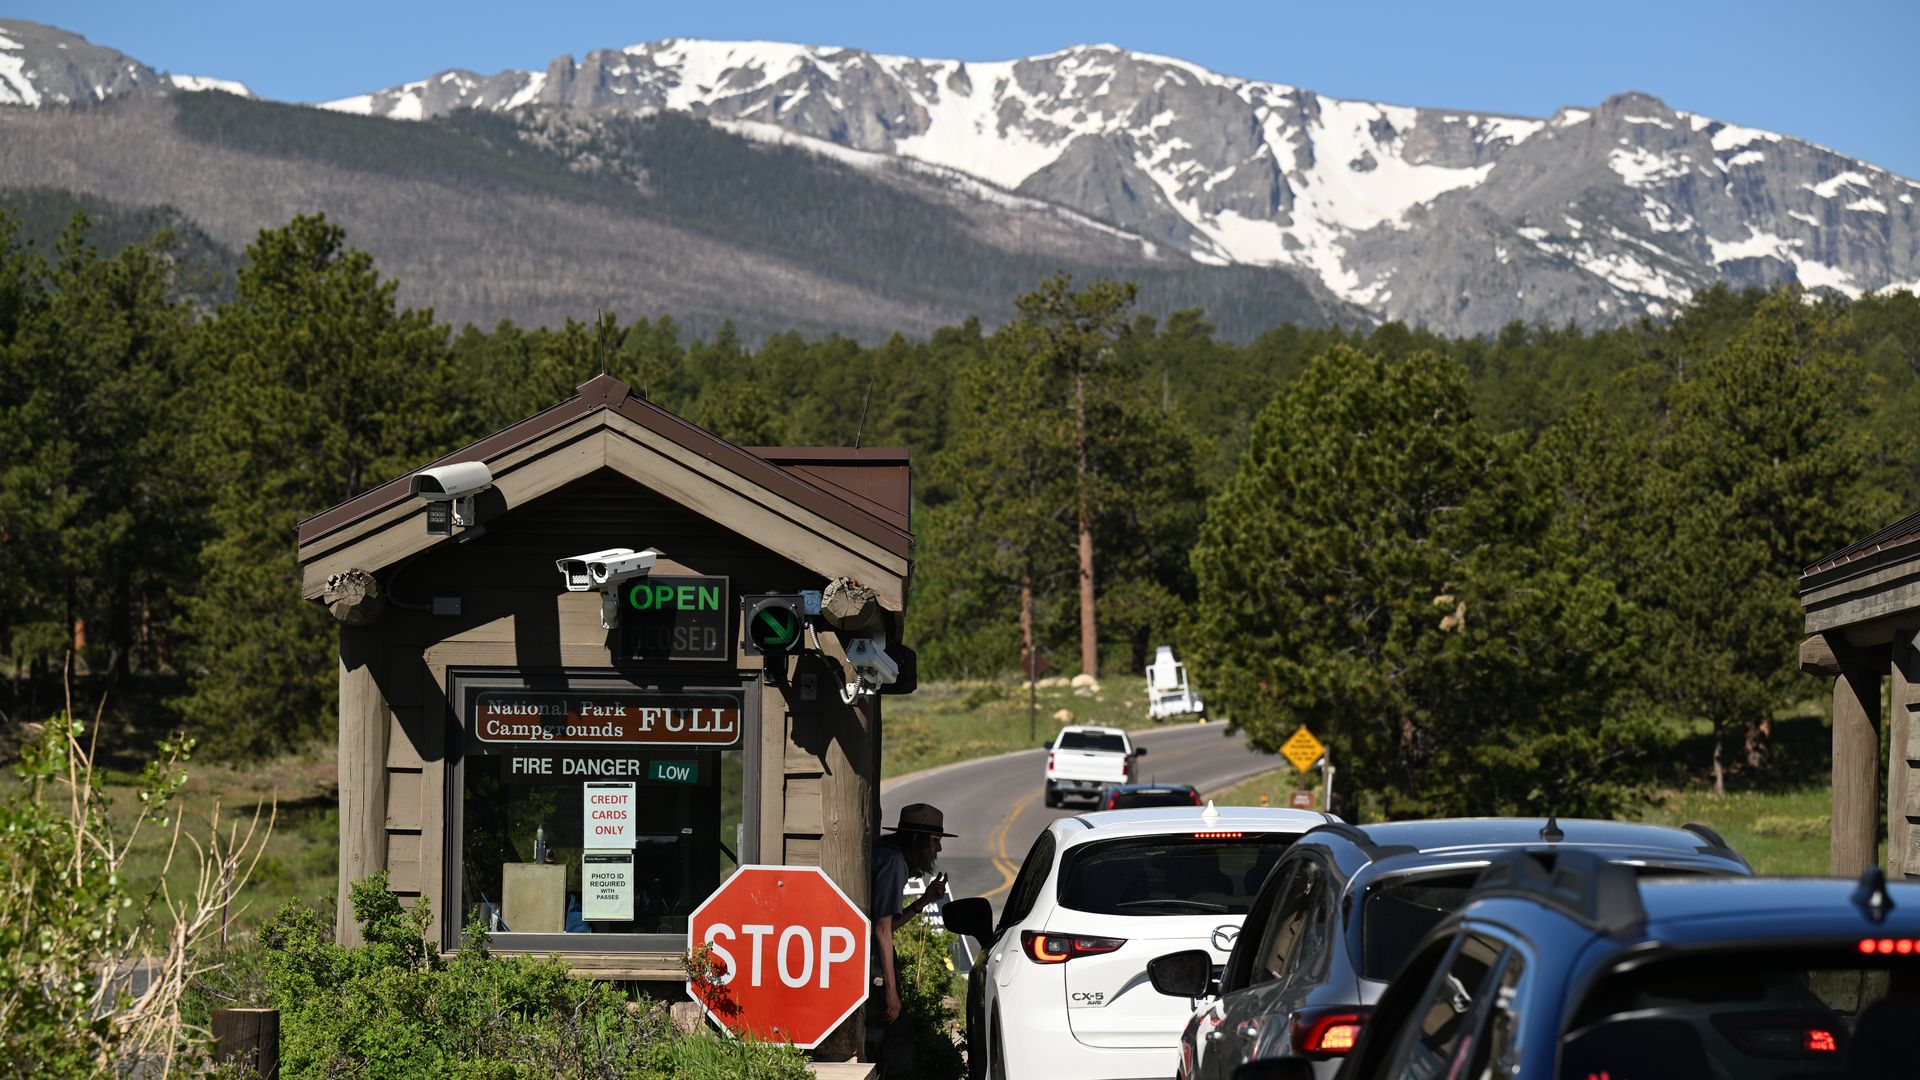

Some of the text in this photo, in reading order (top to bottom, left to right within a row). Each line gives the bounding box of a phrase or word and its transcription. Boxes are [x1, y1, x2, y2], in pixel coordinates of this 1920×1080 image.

[629, 584, 719, 611] OPEN
[487, 699, 627, 717] National Park
[638, 707, 733, 733] FULL
[486, 720, 624, 740] Campgrounds
[512, 757, 641, 776] FIRE DANGER
[658, 765, 690, 781] LOW
[590, 795, 629, 805] CREDIT
[591, 810, 628, 820] CARDS
[595, 825, 624, 835] ONLY
[589, 880, 626, 888] REQUIRED
[704, 923, 856, 989] STOP
[1071, 992, 1105, 1001] CX-5
